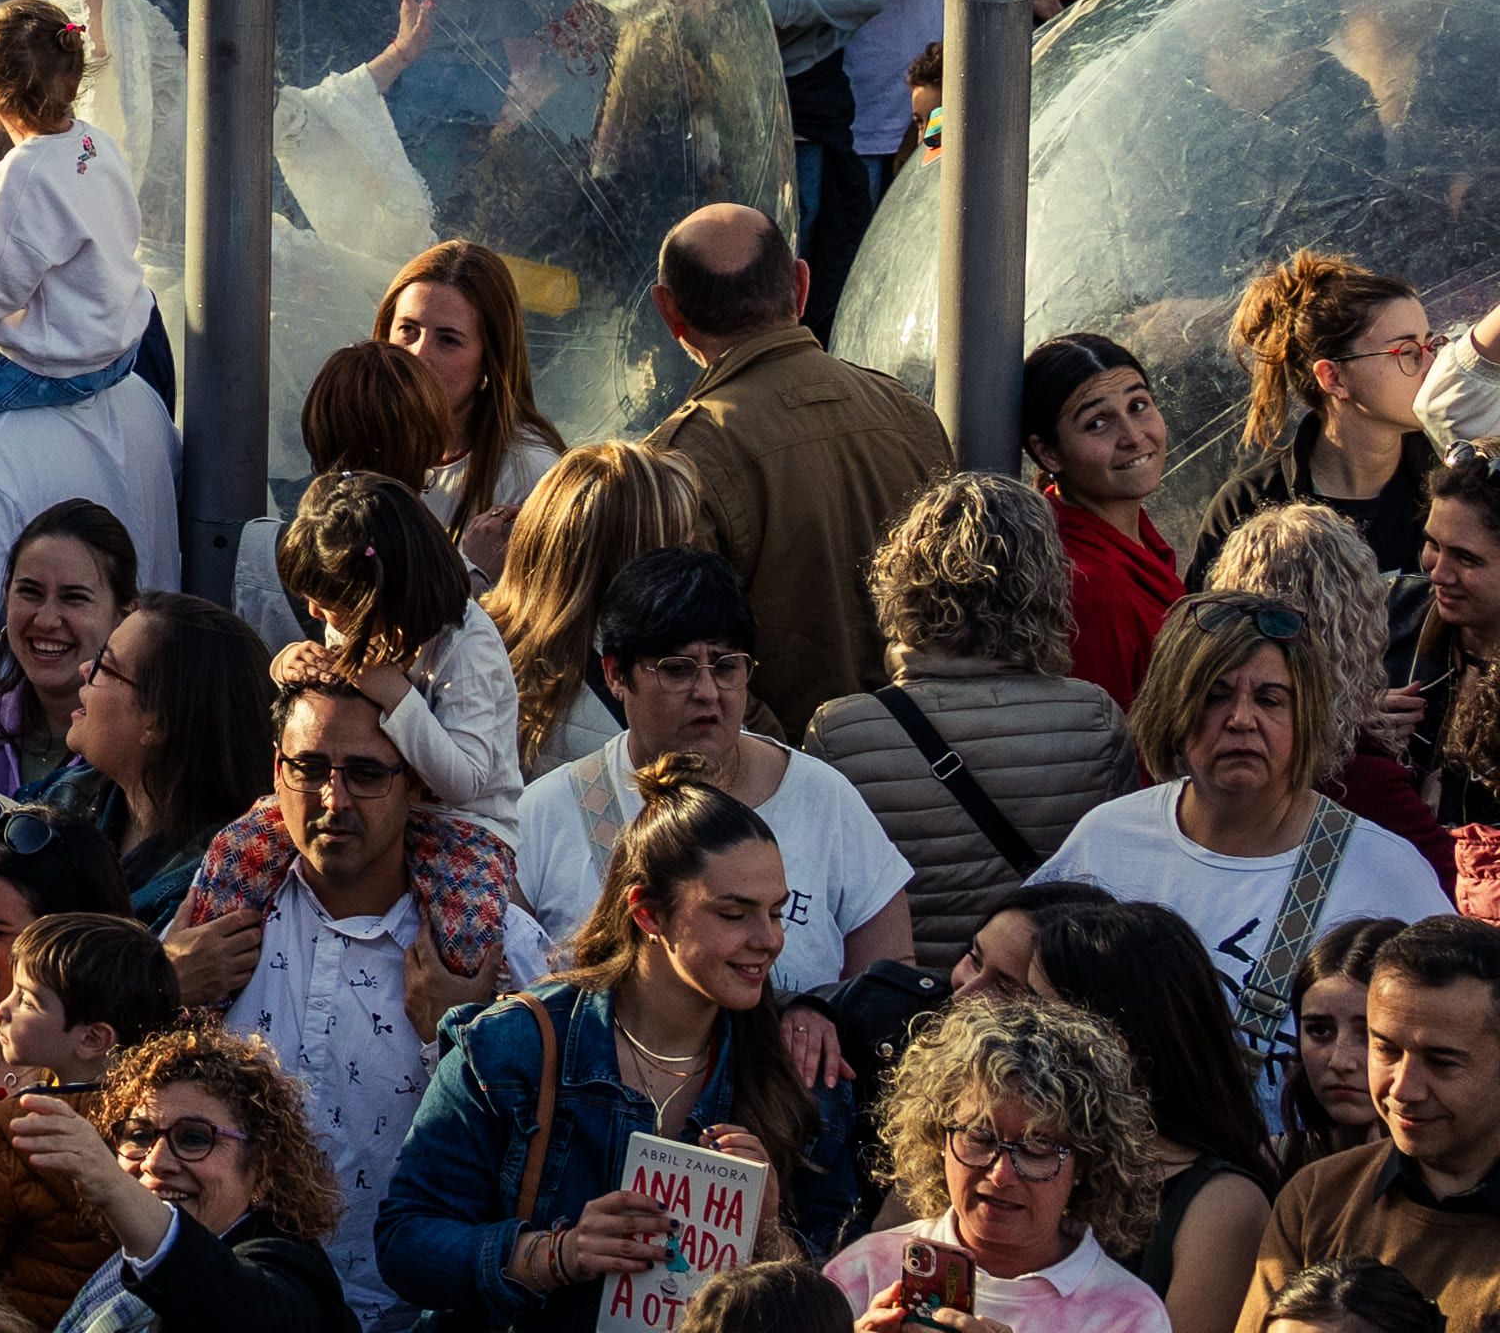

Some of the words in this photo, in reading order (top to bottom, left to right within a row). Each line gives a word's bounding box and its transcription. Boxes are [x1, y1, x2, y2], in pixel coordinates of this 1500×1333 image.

[639, 1147, 679, 1167] ABRIL
[685, 1157, 749, 1183] ZAMORA
[632, 1164, 691, 1218] ANA
[702, 1182, 744, 1237] HA
[622, 1223, 738, 1274] ADO
[610, 1273, 634, 1319] A
[642, 1292, 696, 1332] OT
